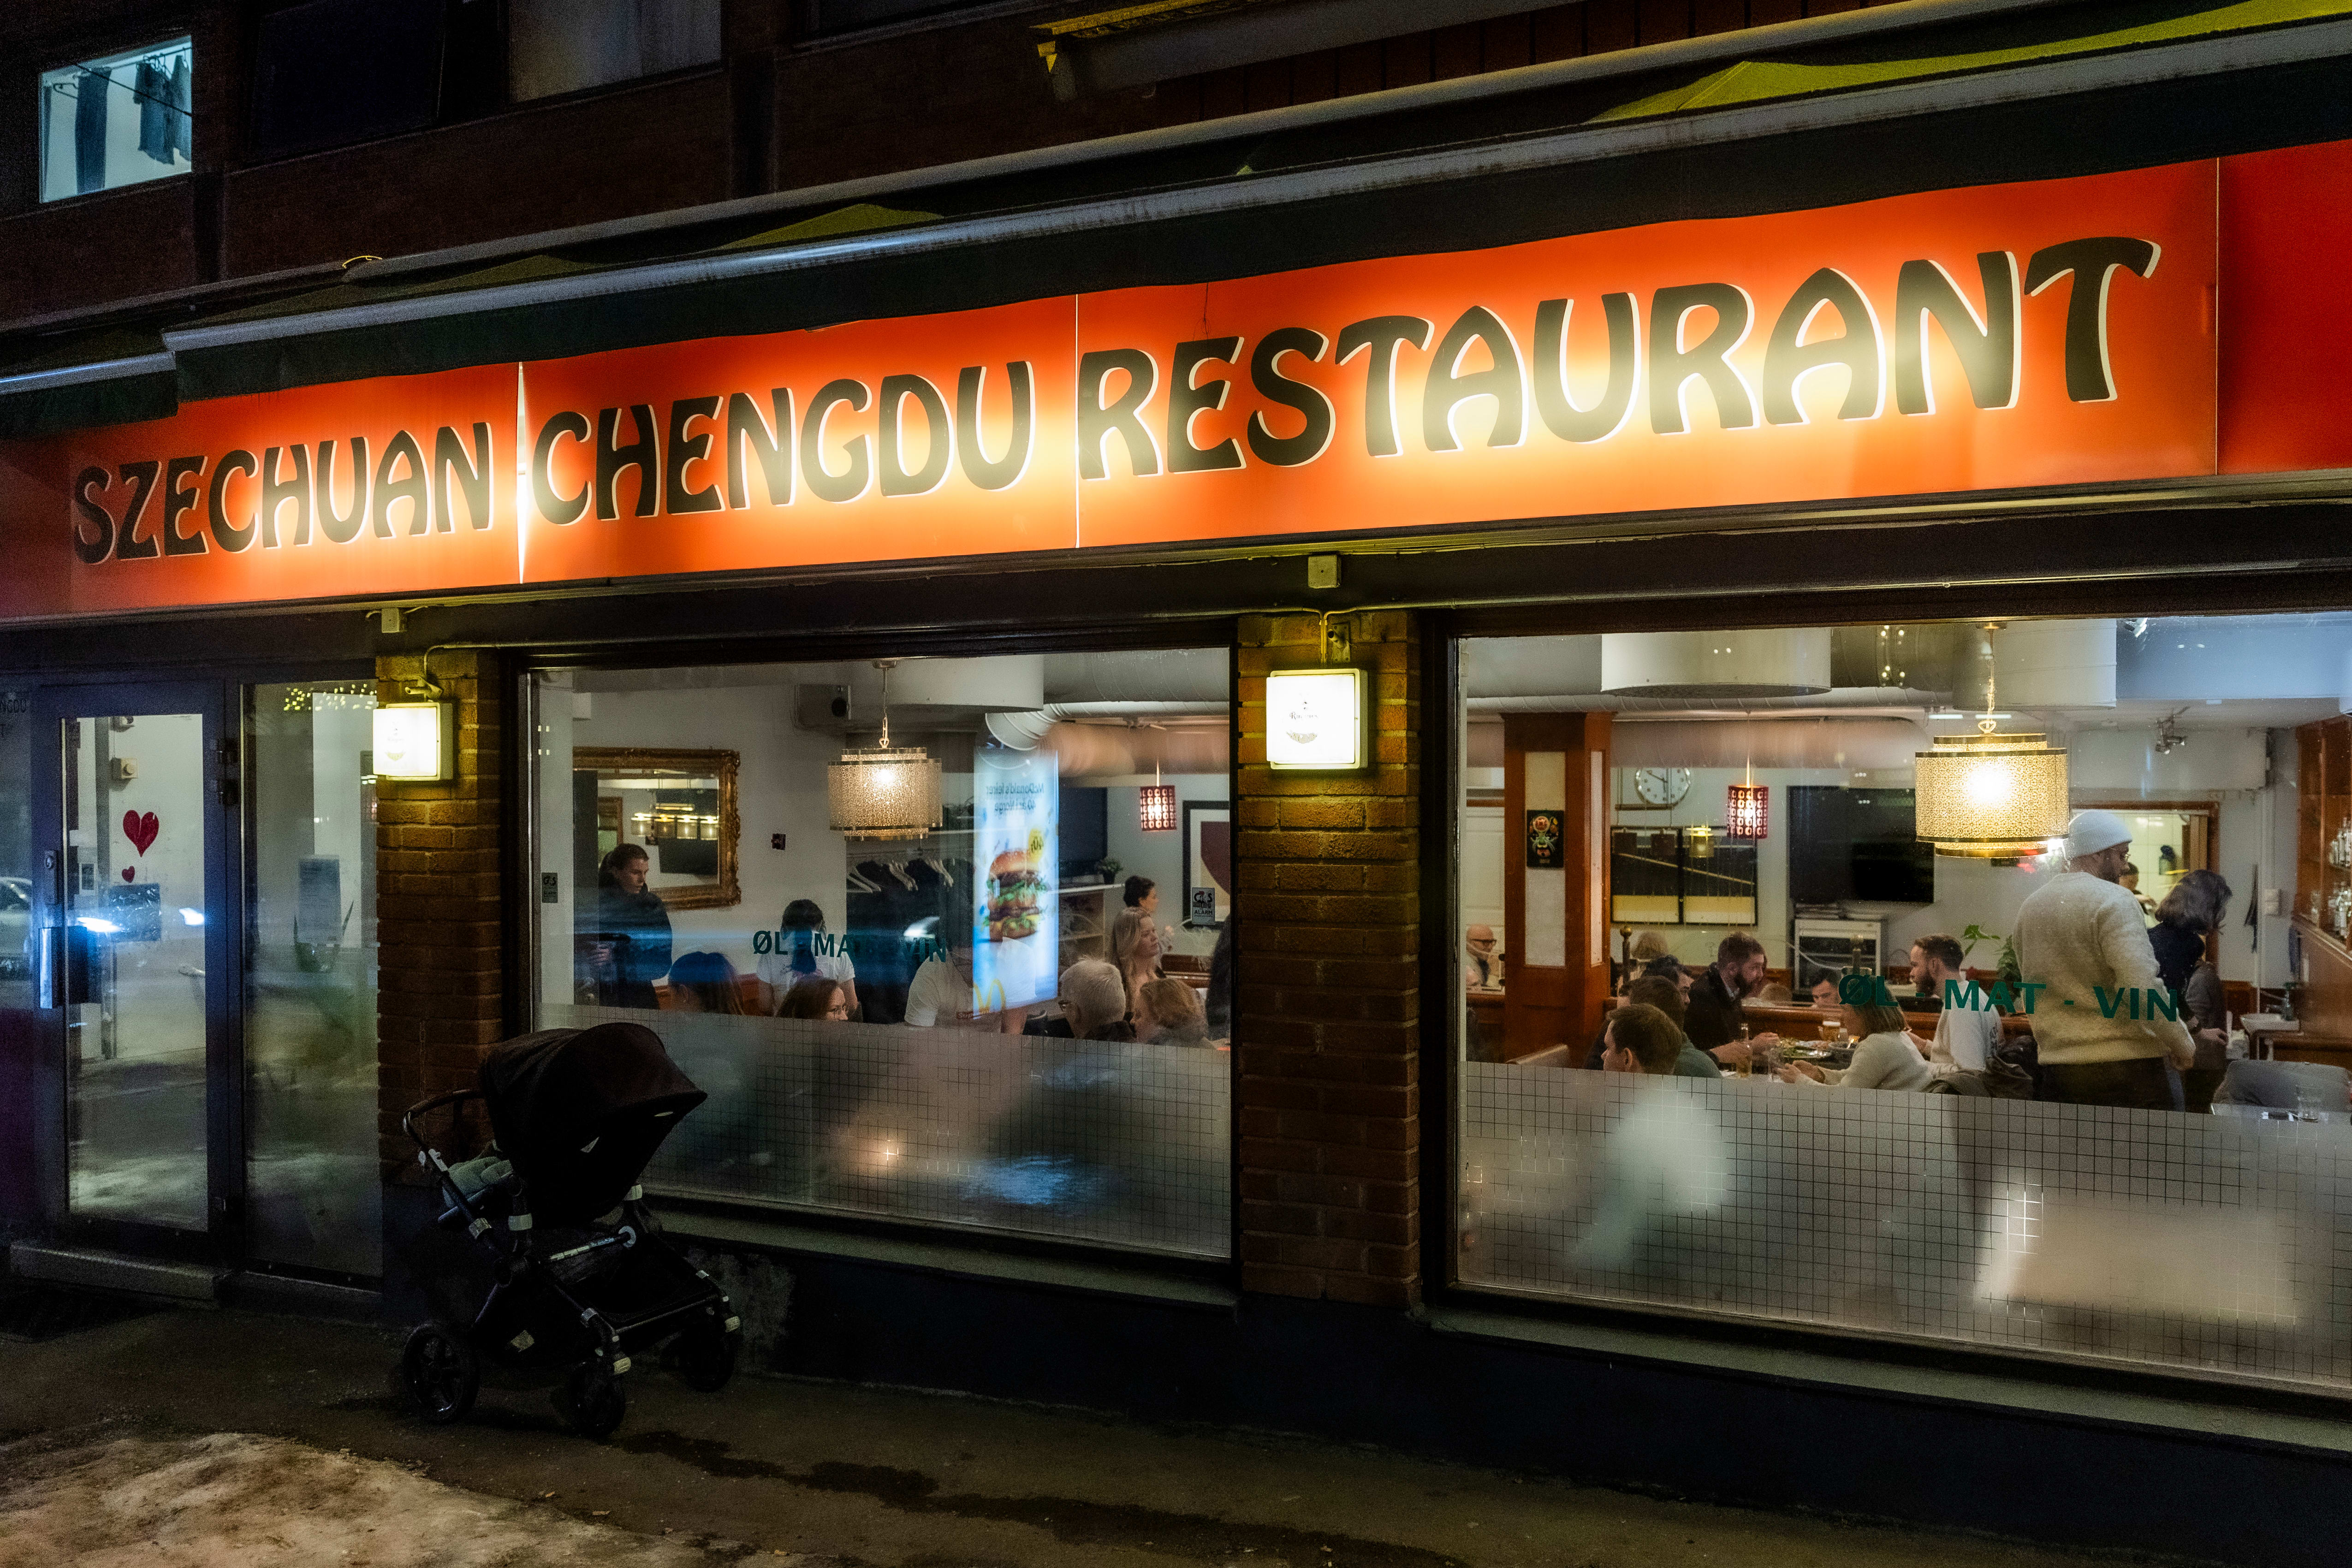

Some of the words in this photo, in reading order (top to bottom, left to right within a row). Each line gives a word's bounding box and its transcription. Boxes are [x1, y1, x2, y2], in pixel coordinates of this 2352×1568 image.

[74, 422, 493, 564] SZECHUAN
[533, 360, 1036, 526] CHENGDU
[1078, 236, 2162, 480] RESTAURANT
[753, 930, 788, 955] ØL
[1839, 974, 1899, 1007] ØL
[1945, 979, 2046, 1015] MAT
[2093, 986, 2177, 1022] VIN
